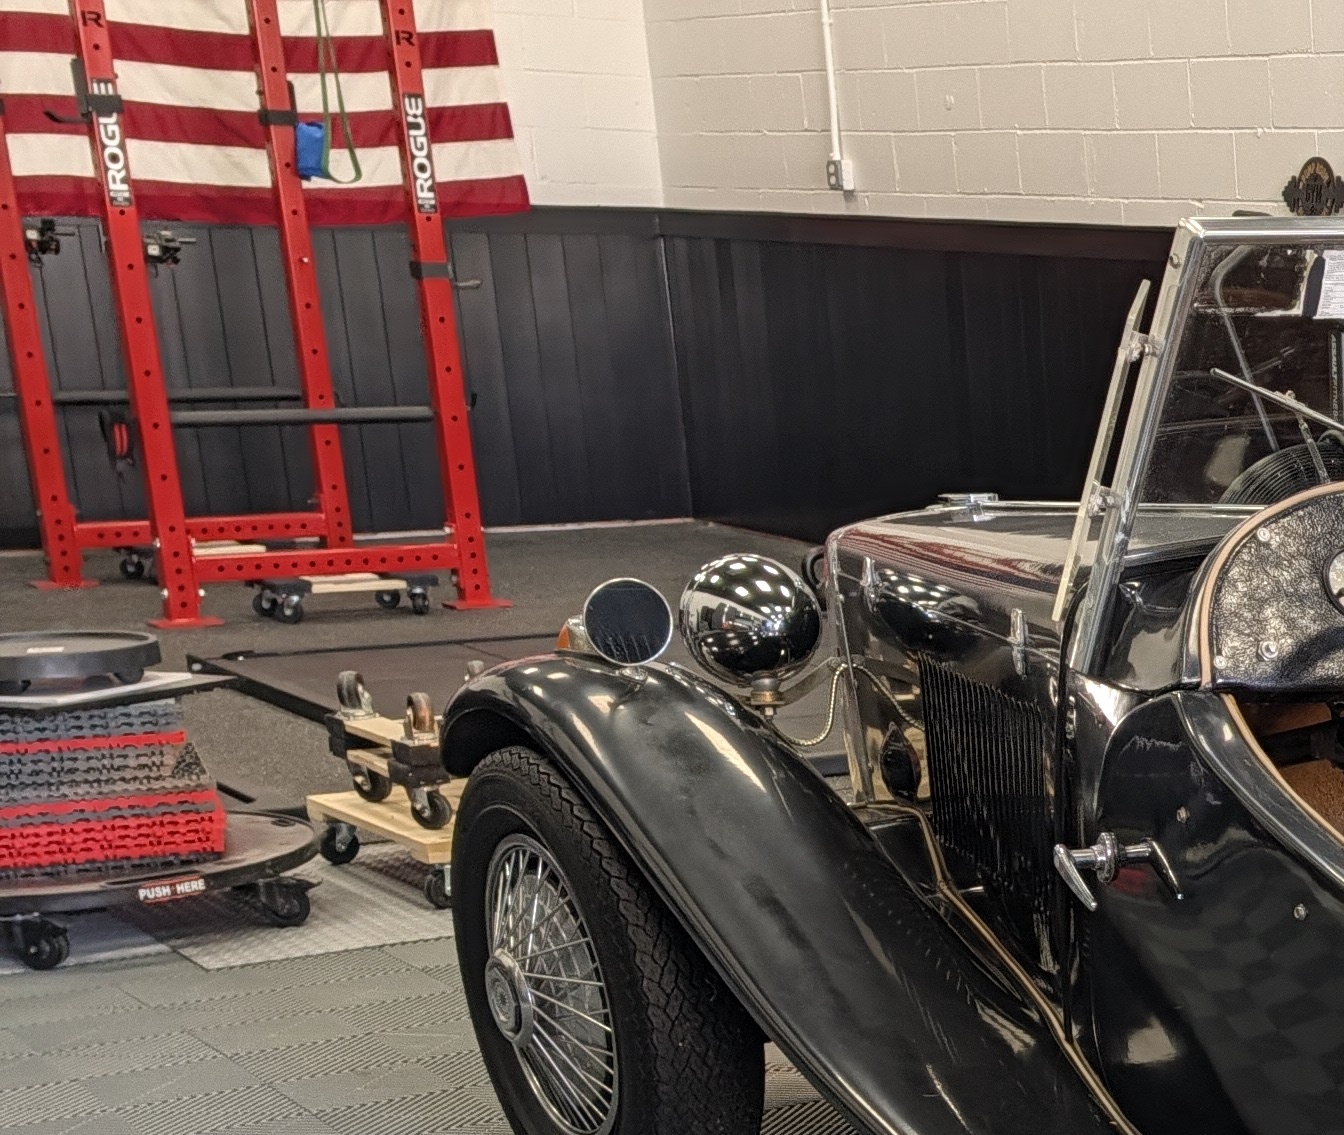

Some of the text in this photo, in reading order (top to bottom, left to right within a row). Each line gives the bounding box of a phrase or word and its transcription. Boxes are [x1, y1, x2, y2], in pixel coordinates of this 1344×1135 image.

[404, 95, 436, 199] ROGUE
[138, 879, 206, 901] PUSH HERE
